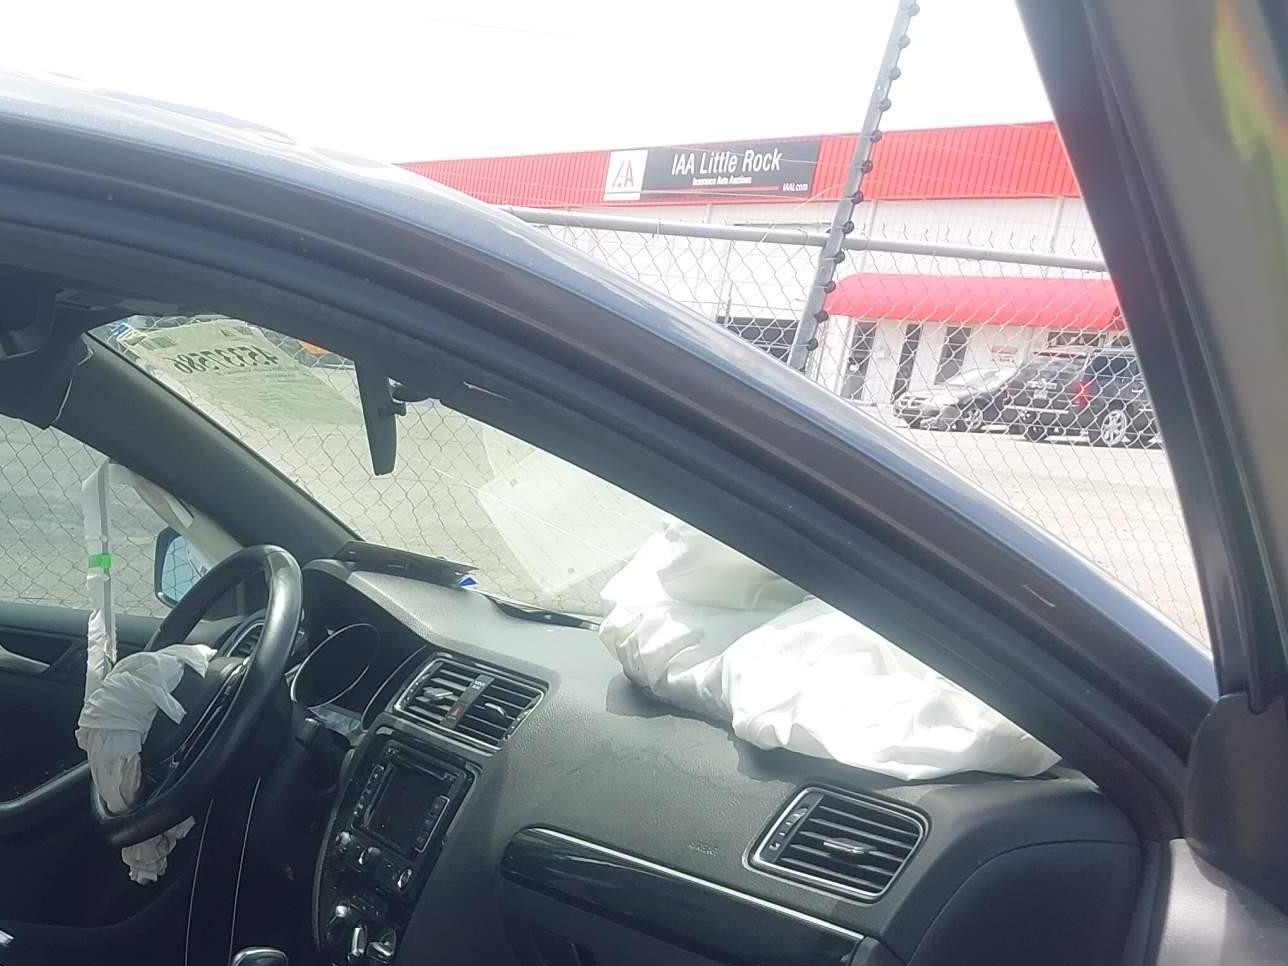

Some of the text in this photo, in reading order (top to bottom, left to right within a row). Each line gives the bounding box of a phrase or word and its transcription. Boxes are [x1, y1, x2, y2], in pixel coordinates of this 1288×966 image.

[672, 148, 783, 176] IAA Little Rock
